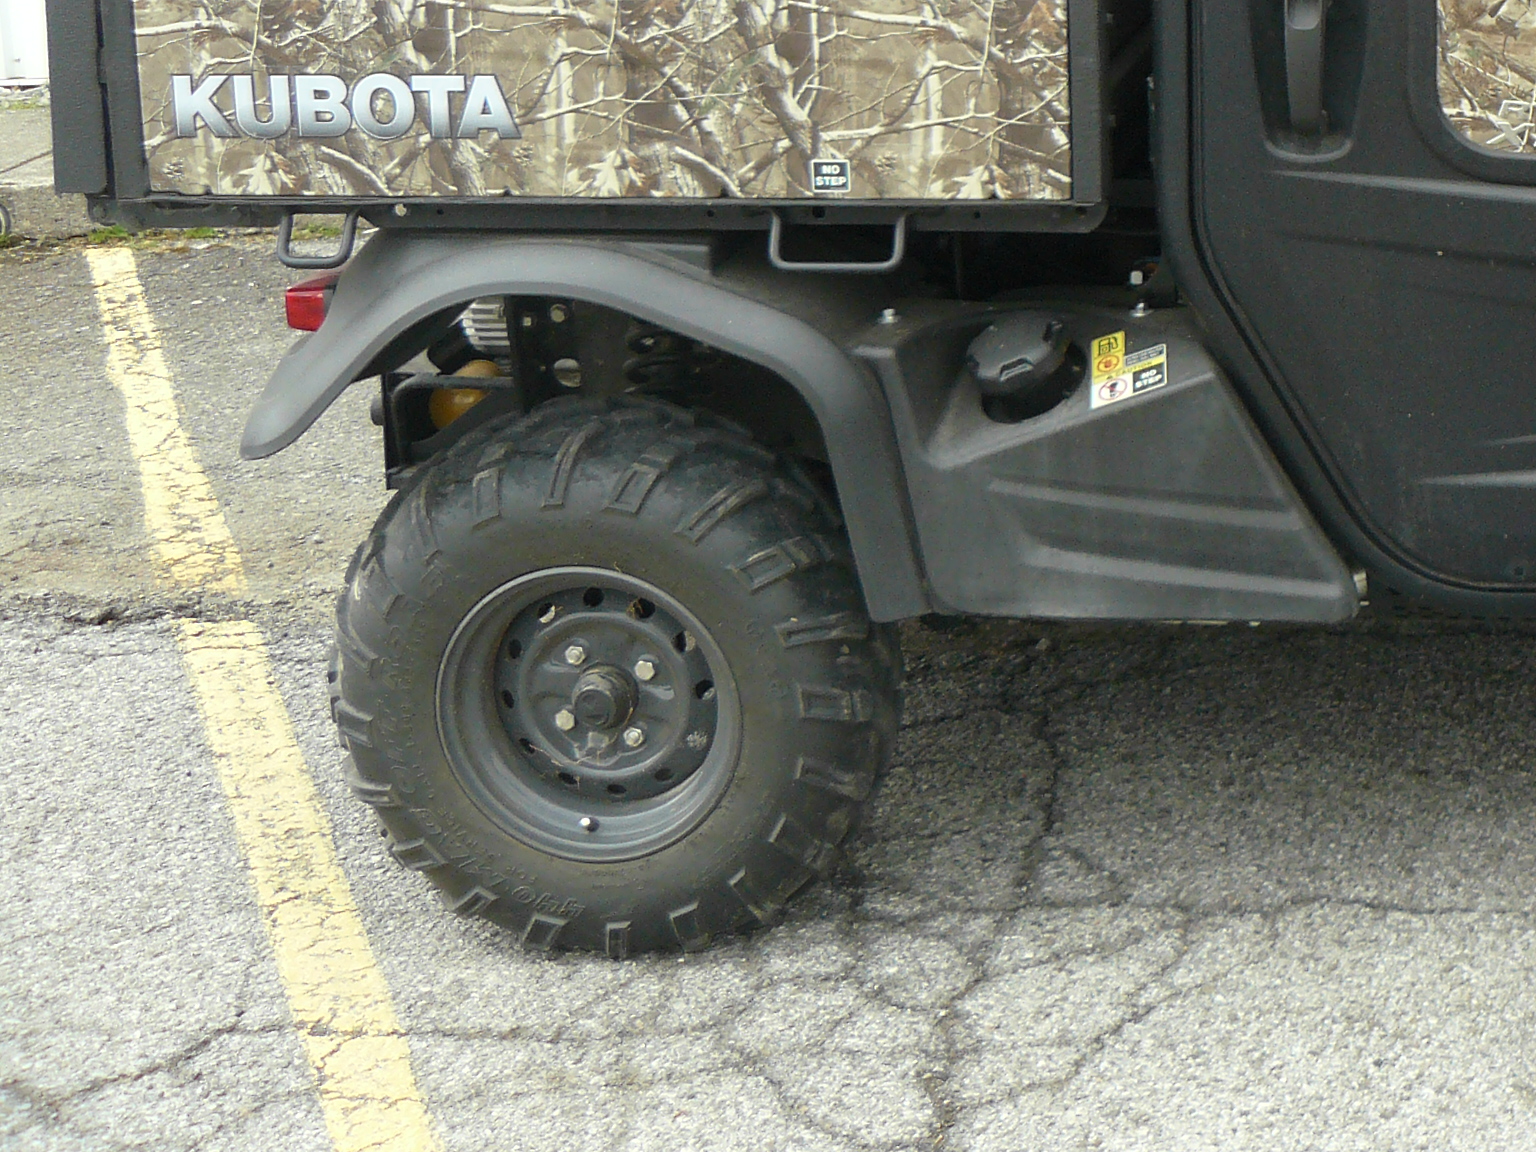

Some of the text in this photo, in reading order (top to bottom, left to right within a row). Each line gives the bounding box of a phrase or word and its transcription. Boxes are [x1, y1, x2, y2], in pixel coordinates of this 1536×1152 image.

[171, 71, 522, 140] KUBOTA
[821, 164, 841, 175] NO
[815, 176, 848, 186] STEP
[1140, 369, 1158, 380] NO
[1135, 374, 1162, 389] STEP
